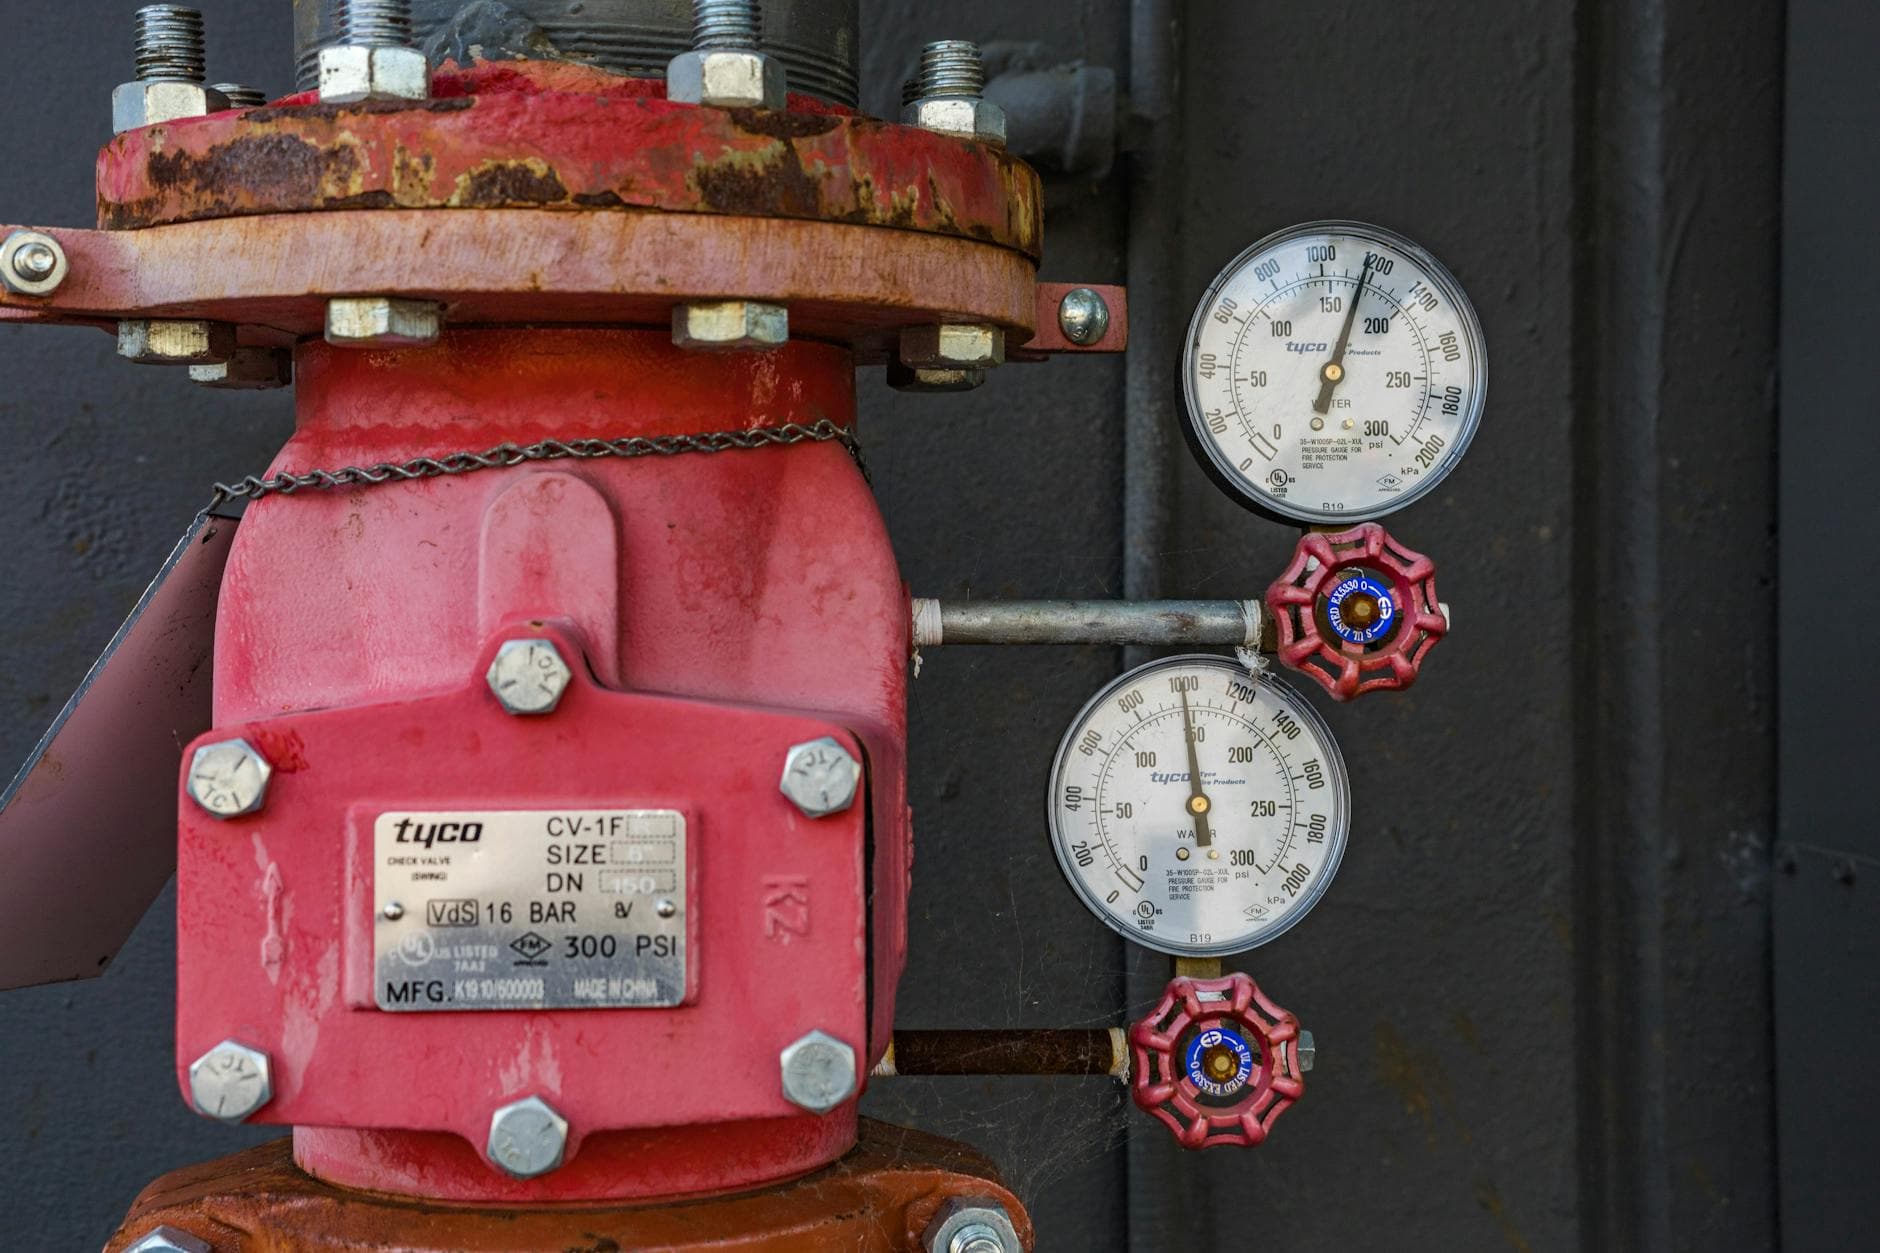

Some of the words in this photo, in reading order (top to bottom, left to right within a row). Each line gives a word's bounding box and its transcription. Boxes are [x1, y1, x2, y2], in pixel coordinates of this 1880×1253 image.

[1306, 245, 1336, 263] 1000
[1254, 258, 1280, 282] 800
[1320, 297, 1341, 313] 150
[1407, 281, 1438, 312] 1400
[1214, 297, 1238, 324] 600
[1271, 320, 1291, 337] 100
[1365, 318, 1389, 334] 200
[1285, 341, 1327, 354] tyco
[1439, 330, 1460, 362] 1600
[1200, 353, 1217, 379] 400
[1251, 371, 1266, 387] 50
[1386, 371, 1411, 388] 250
[1312, 400, 1351, 408] TER
[1441, 386, 1462, 416] 1800
[1206, 409, 1227, 435] 200
[1364, 420, 1389, 437] 300
[1273, 424, 1281, 439] 0
[1369, 439, 1383, 450] psi
[1415, 434, 1445, 468] 2000
[1240, 458, 1253, 471] 0
[1401, 467, 1419, 475] kPa
[1275, 473, 1283, 483] UL
[1323, 503, 1344, 511] B19
[1330, 607, 1350, 637] LISTED
[1353, 631, 1363, 641] UL
[1366, 629, 1372, 638] S
[1169, 675, 1198, 693] 1000
[1225, 681, 1256, 704] 1200
[1118, 690, 1144, 714] 800
[1271, 709, 1301, 740] 1400
[1078, 730, 1102, 757] 600
[1135, 751, 1156, 768] 100
[1228, 747, 1253, 764] 200
[1150, 772, 1192, 784] tyco
[1303, 758, 1324, 790] 1600
[1065, 786, 1082, 812] 400
[1116, 803, 1132, 819] 50
[1251, 801, 1276, 817] 250
[393, 817, 483, 849] tyco
[546, 817, 624, 836] CV-1F
[1177, 830, 1216, 838] WAR
[1308, 814, 1327, 844] 1800
[387, 857, 416, 865] CHECK
[421, 857, 451, 865] VALVE
[547, 844, 606, 864] SIZE
[1072, 841, 1093, 867] 200
[1230, 850, 1254, 866] 300
[1140, 855, 1148, 871] 0
[547, 873, 583, 892] DN
[1235, 870, 1250, 880] psi
[1281, 863, 1311, 898] 2000
[1106, 890, 1120, 904] 0
[1268, 896, 1285, 905] kPa
[431, 902, 475, 923] VdS
[487, 902, 512, 923] 16
[530, 902, 576, 923] BAR
[1141, 905, 1150, 915] UL
[519, 939, 541, 949] FM
[564, 935, 616, 958] 300
[636, 935, 676, 957] PSI
[1190, 934, 1211, 943] B19
[454, 946, 499, 958] LISTED
[387, 981, 452, 1003] MFG.
[574, 978, 607, 998] MADE
[609, 977, 622, 998] IN
[623, 978, 658, 998] CHINA
[1240, 1052, 1250, 1064] UL
[1224, 1067, 1250, 1092] LISTED
